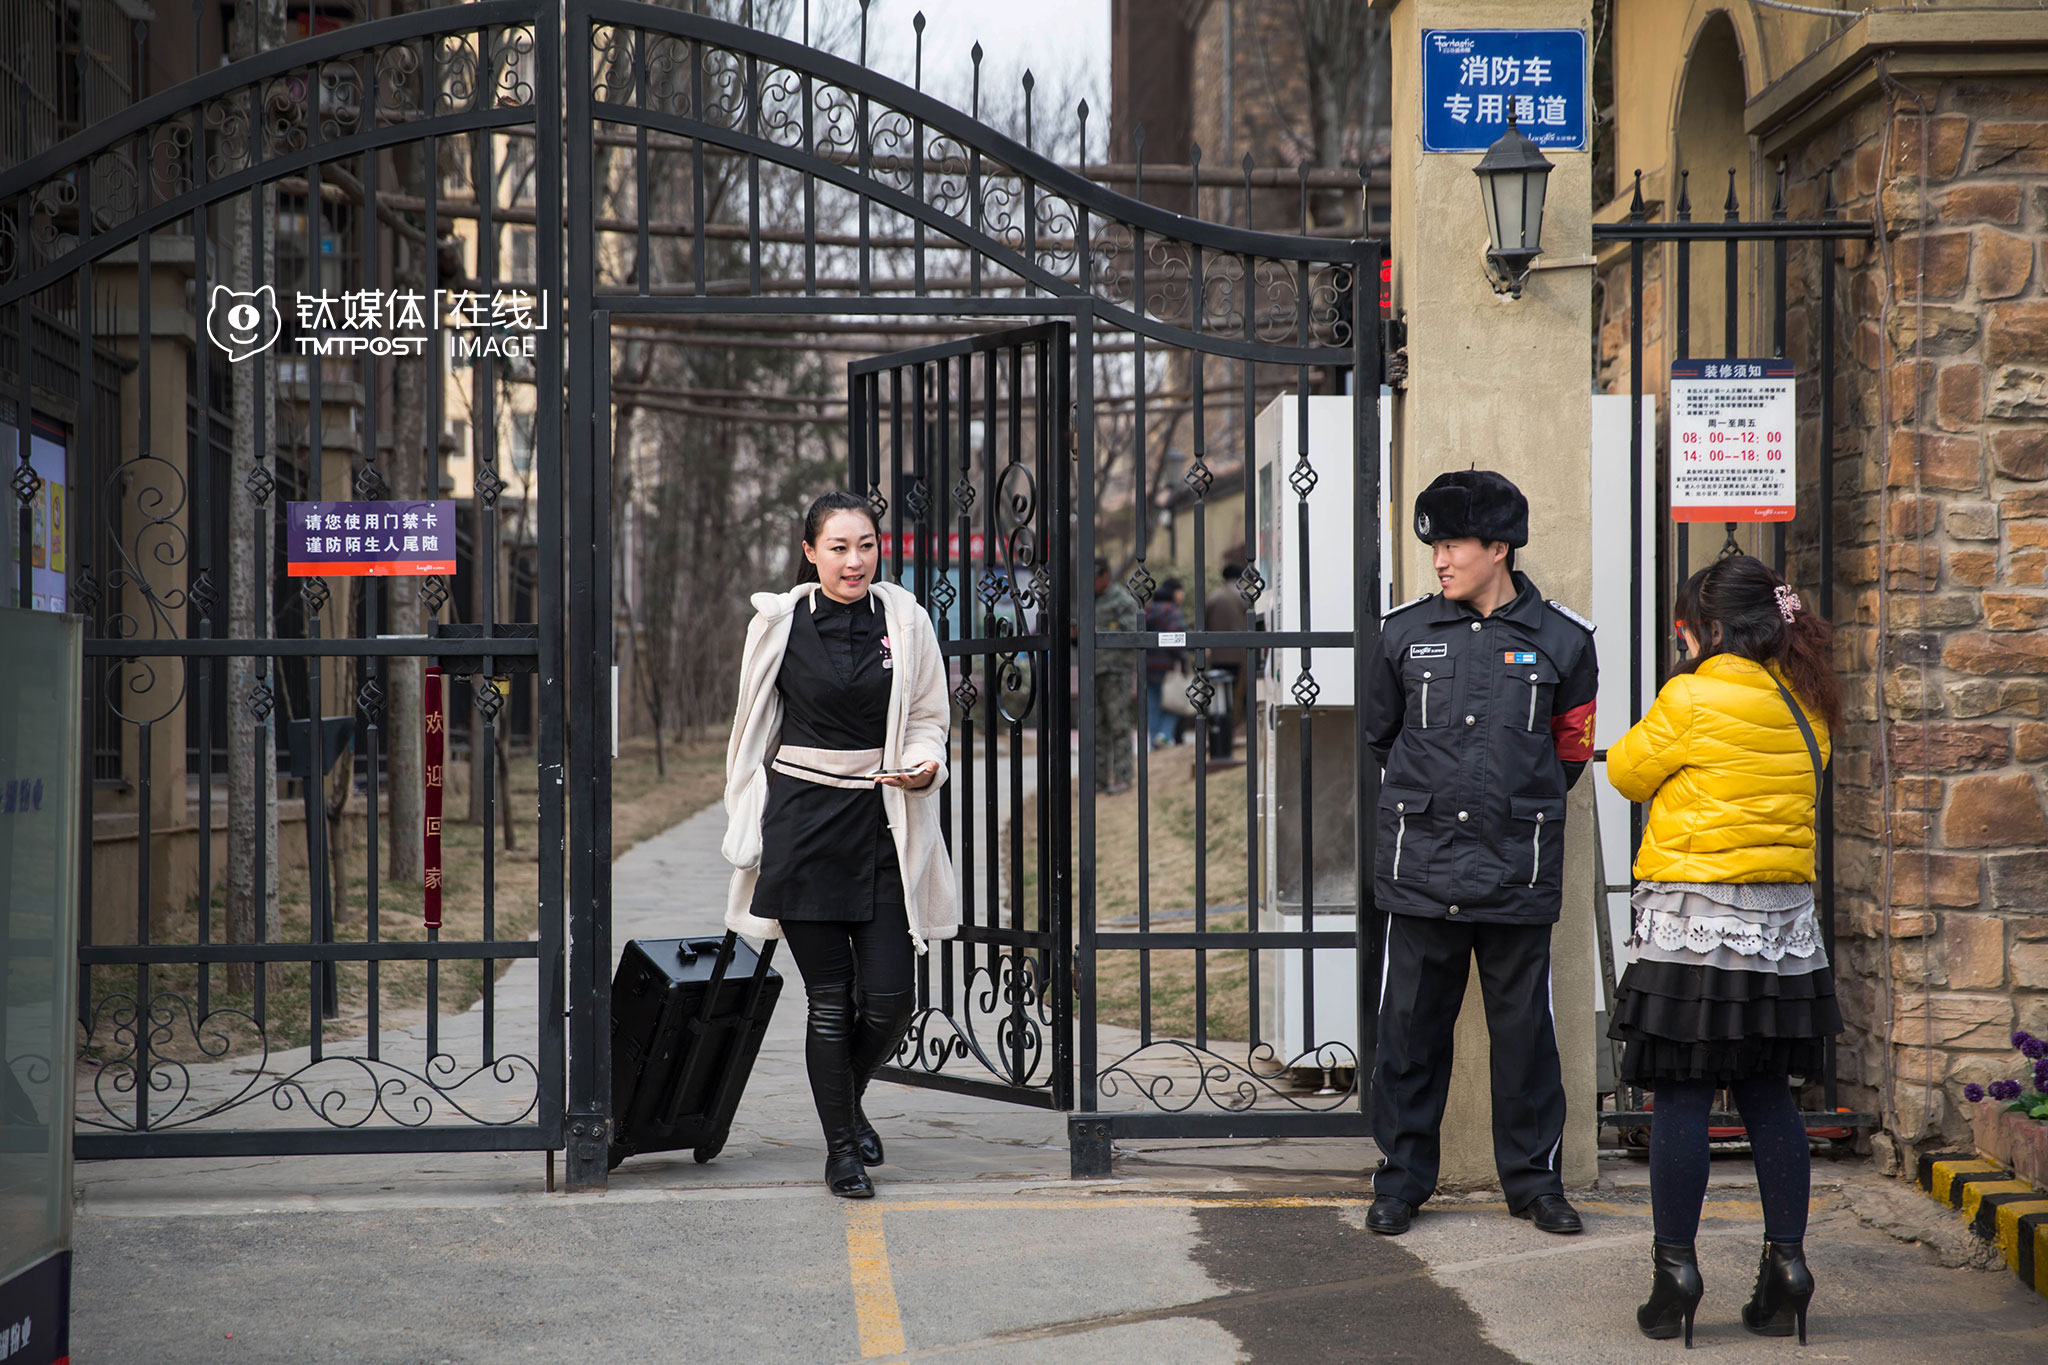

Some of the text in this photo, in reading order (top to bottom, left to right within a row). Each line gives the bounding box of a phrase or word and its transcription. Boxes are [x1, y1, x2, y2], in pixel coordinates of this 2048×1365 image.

[1459, 54, 1552, 86] 消防车
[1443, 92, 1567, 126] 专用通道
[1704, 364, 1762, 378] 装修须知
[1708, 418, 1757, 428] 周一至周五
[305, 512, 438, 531] 请您使用门禁卡
[305, 535, 439, 553] 谨防陌生人尾随
[425, 711, 443, 890] 欢迎回家
